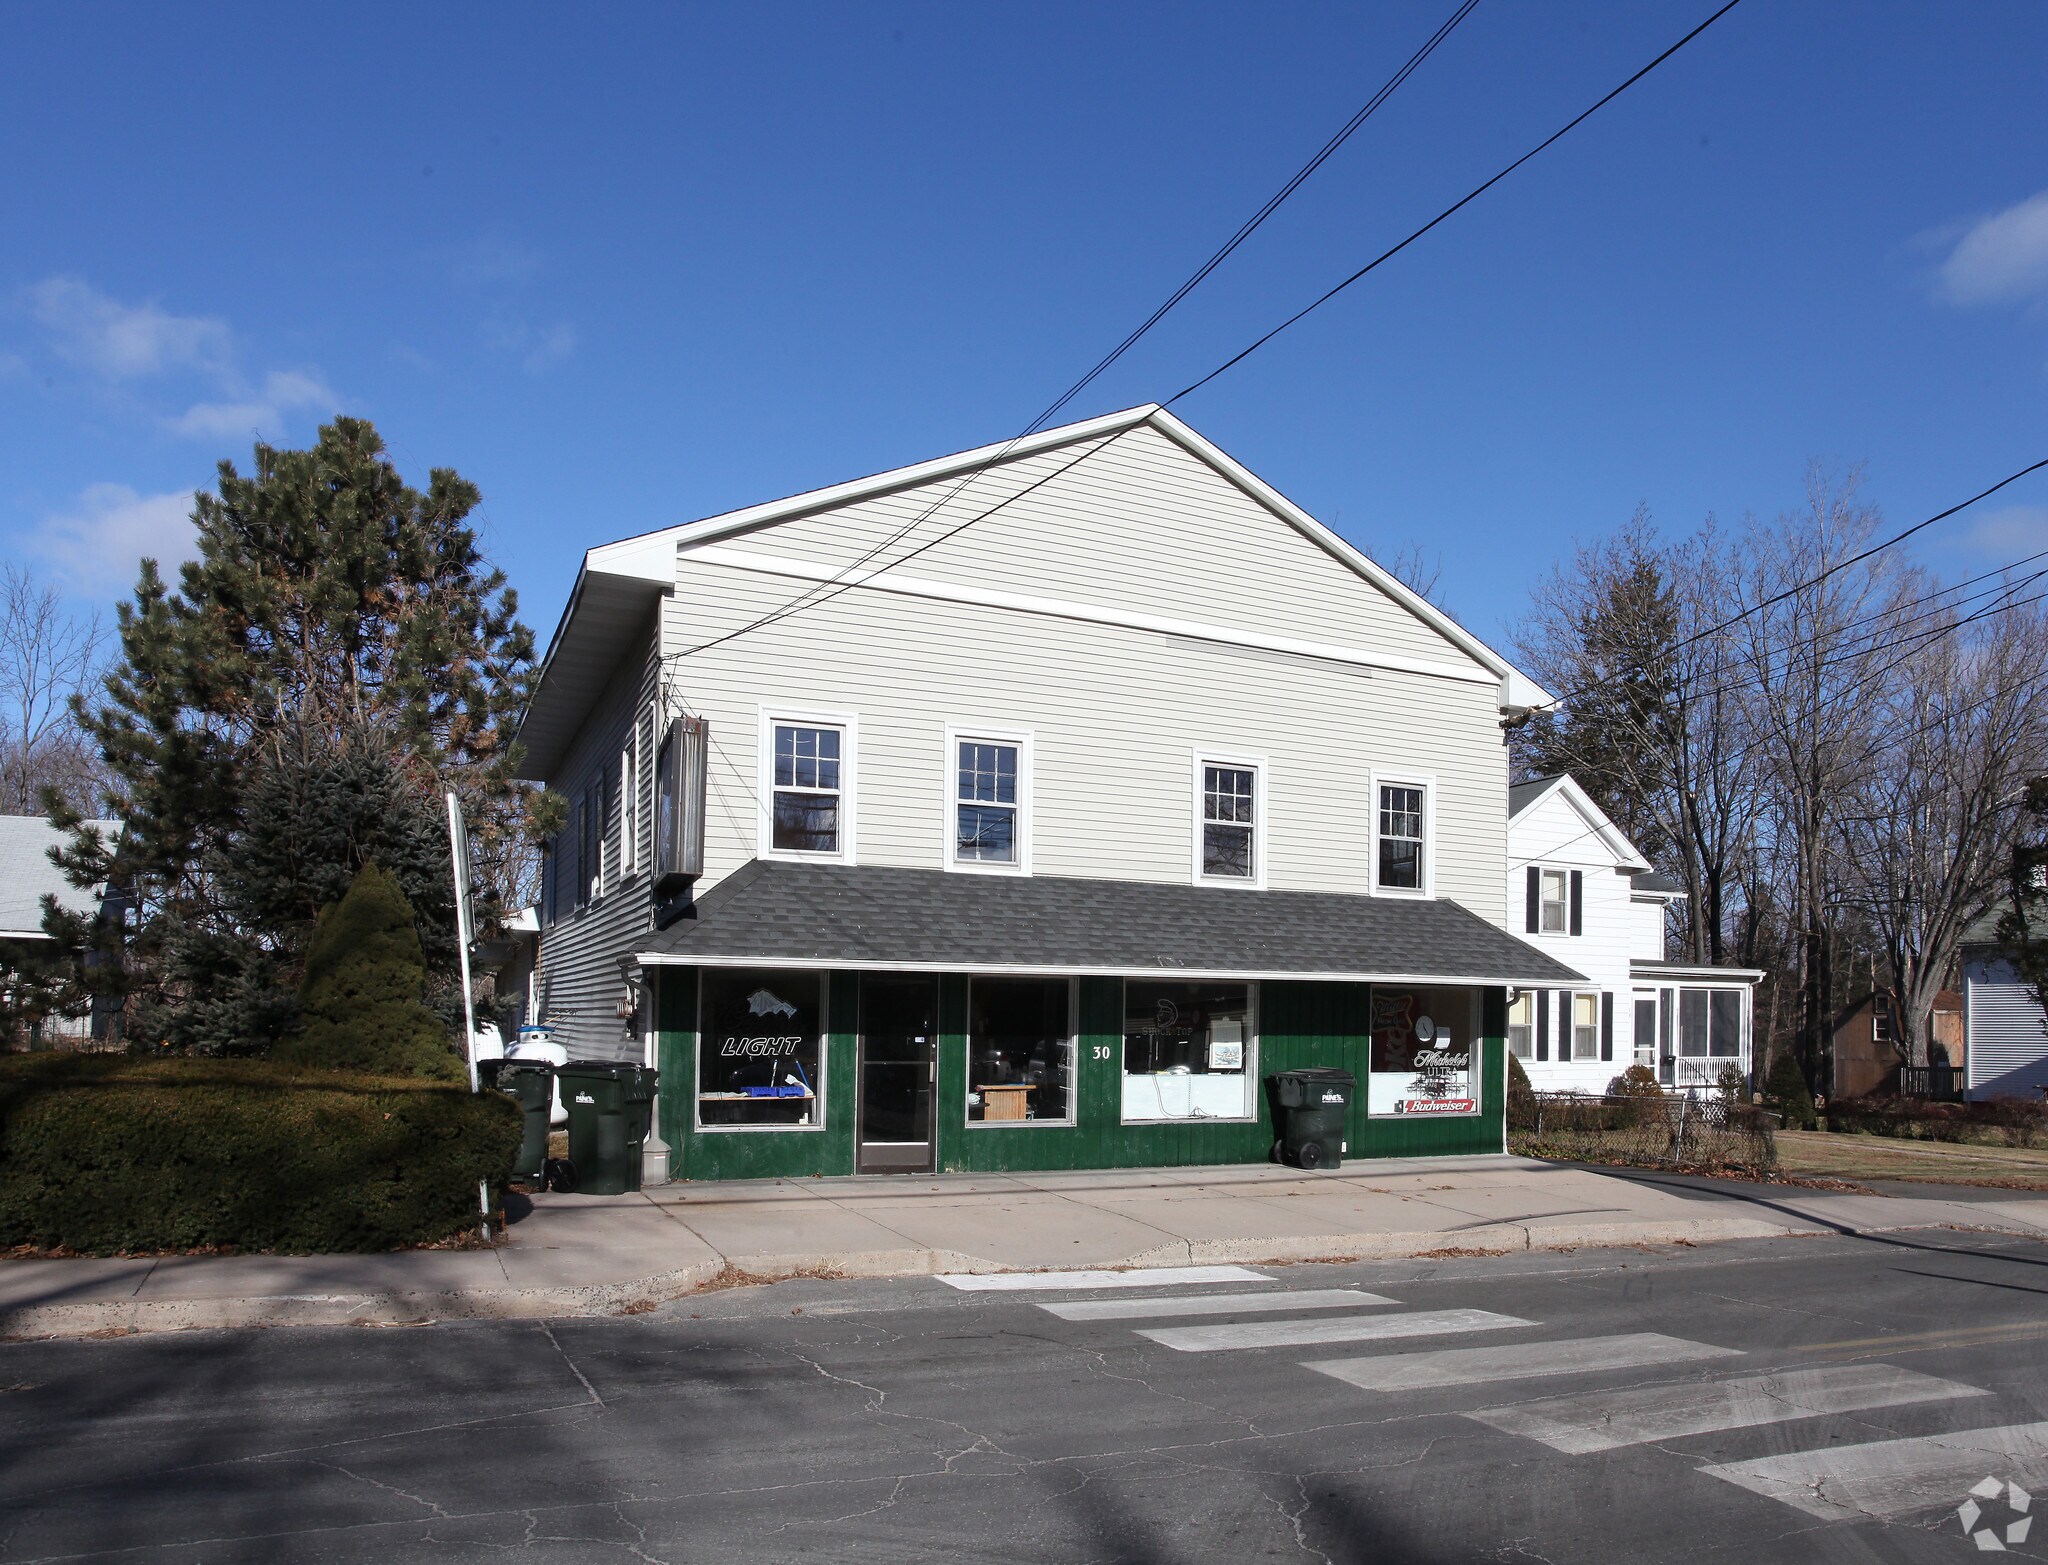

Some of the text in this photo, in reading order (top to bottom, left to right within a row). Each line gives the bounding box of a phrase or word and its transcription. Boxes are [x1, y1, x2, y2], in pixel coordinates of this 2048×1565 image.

[1142, 1027, 1193, 1036] SHOCK TOP
[721, 1036, 802, 1056] LIGHT
[1092, 1046, 1110, 1060] 30
[1413, 1050, 1469, 1067] Michelob
[1427, 1067, 1458, 1077] ULTRA
[1410, 1100, 1468, 1112] Budweiser
